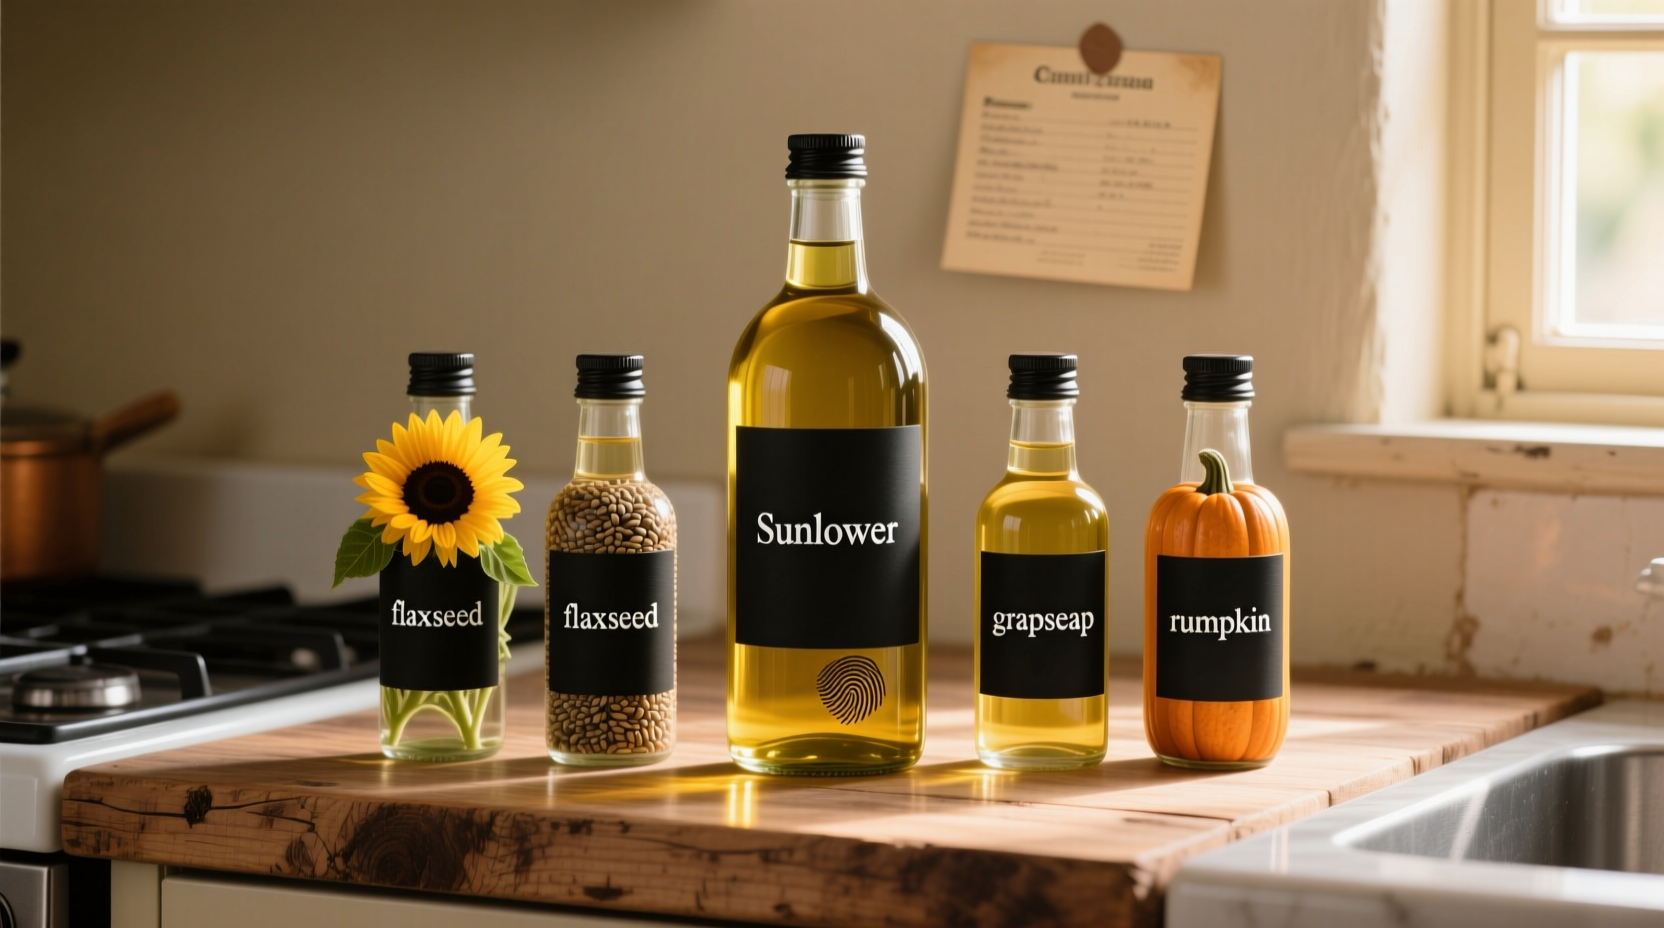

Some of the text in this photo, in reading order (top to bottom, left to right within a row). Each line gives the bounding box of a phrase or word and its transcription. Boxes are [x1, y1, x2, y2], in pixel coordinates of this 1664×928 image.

[757, 512, 899, 546] Sunlower
[391, 599, 484, 628] flaxseed
[563, 602, 660, 630] flaxseed
[992, 610, 1095, 638] grapseap
[1169, 607, 1272, 641] rumpkin
